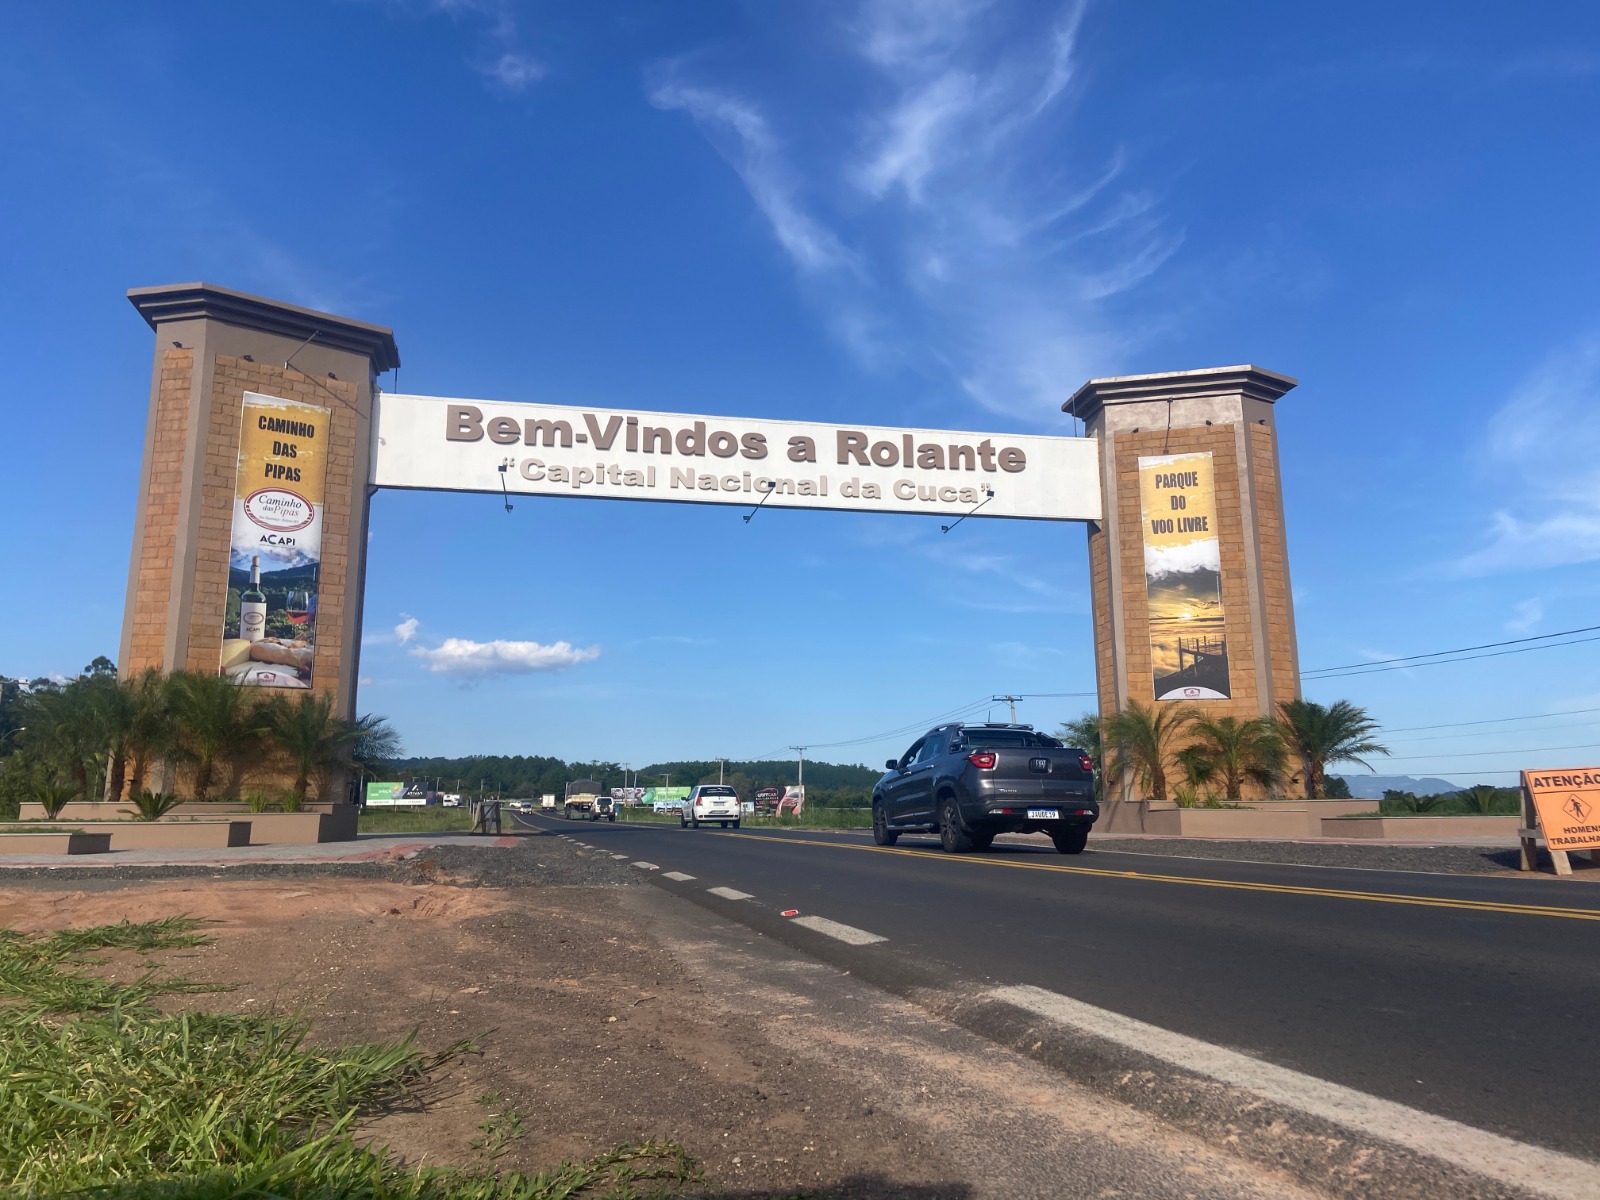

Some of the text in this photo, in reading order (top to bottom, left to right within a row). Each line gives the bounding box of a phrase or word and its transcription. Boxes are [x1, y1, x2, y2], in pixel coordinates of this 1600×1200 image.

[258, 415, 315, 438] CAMINHO
[446, 404, 1027, 473] Bem-Vindos a Rolante
[272, 440, 297, 459] DAS
[264, 462, 301, 482] PIPAS
[1155, 471, 1199, 489] PARQUE
[669, 466, 828, 497] Nacional
[839, 477, 882, 499] da
[258, 494, 302, 509] Caminho
[1170, 495, 1186, 511] DO
[1151, 516, 1209, 535] VOO LIVRE
[259, 534, 296, 546] ACAPI
[1534, 772, 1600, 788] ATENÇÃO
